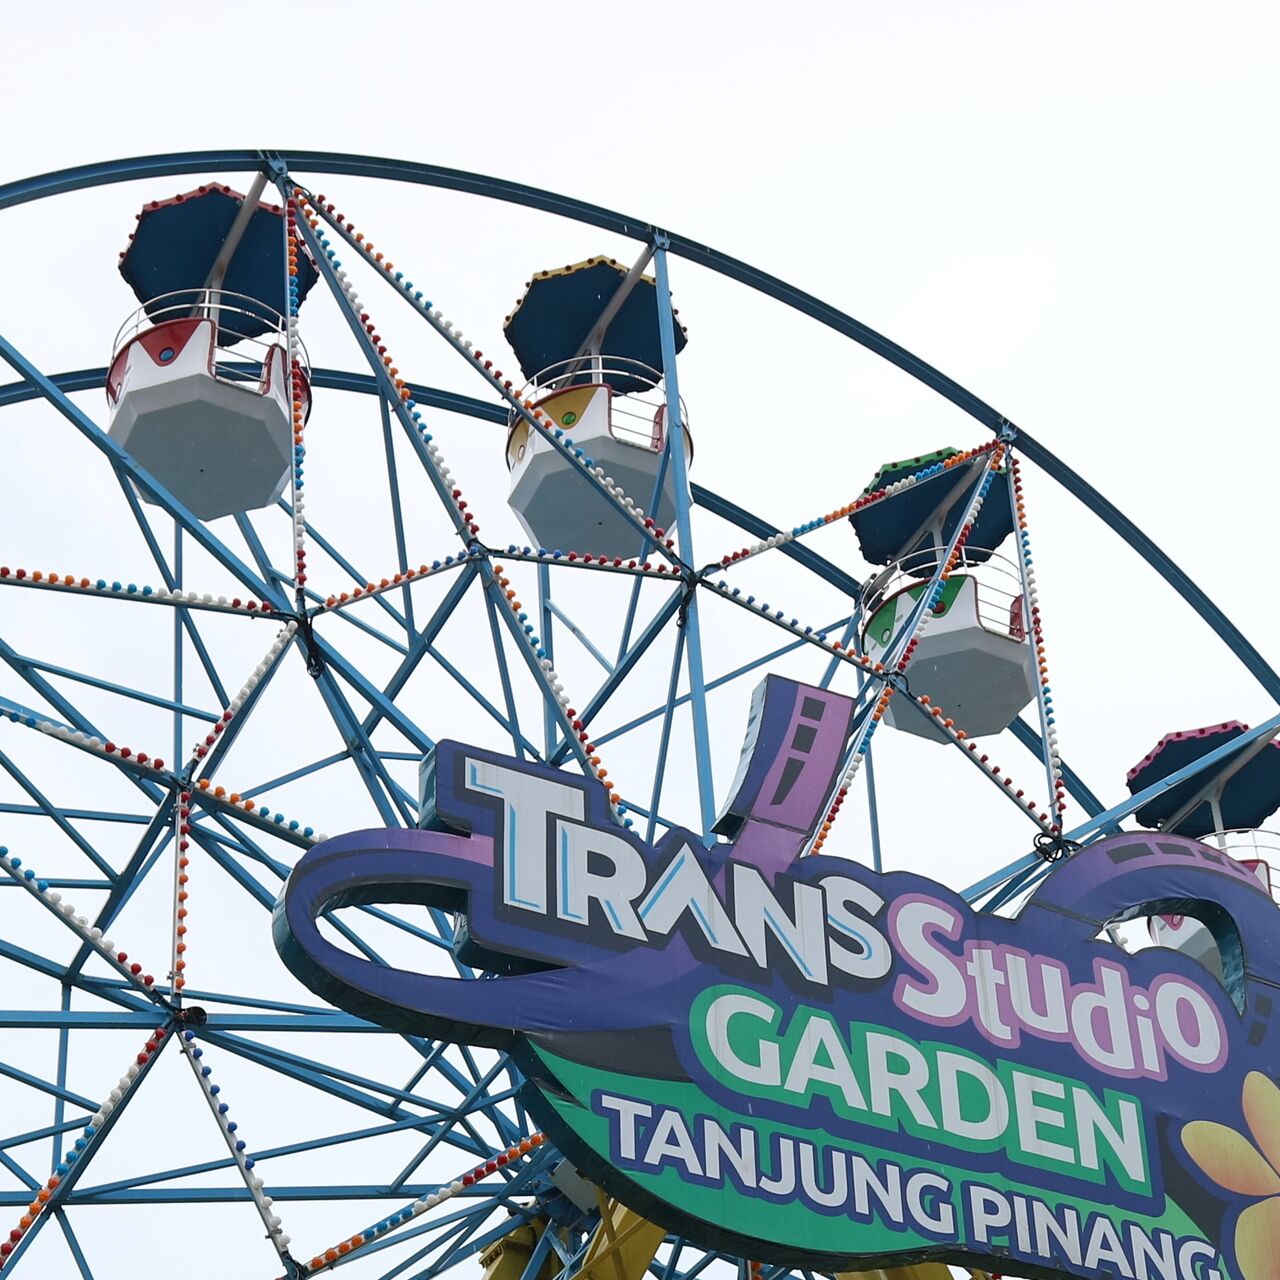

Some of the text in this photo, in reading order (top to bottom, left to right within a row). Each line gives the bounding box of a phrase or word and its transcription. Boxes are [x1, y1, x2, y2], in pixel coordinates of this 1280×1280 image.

[464, 755, 1222, 1074] TRANS Studio
[600, 1094, 956, 1234] TANJUNG
[704, 993, 1147, 1184] GARDEN
